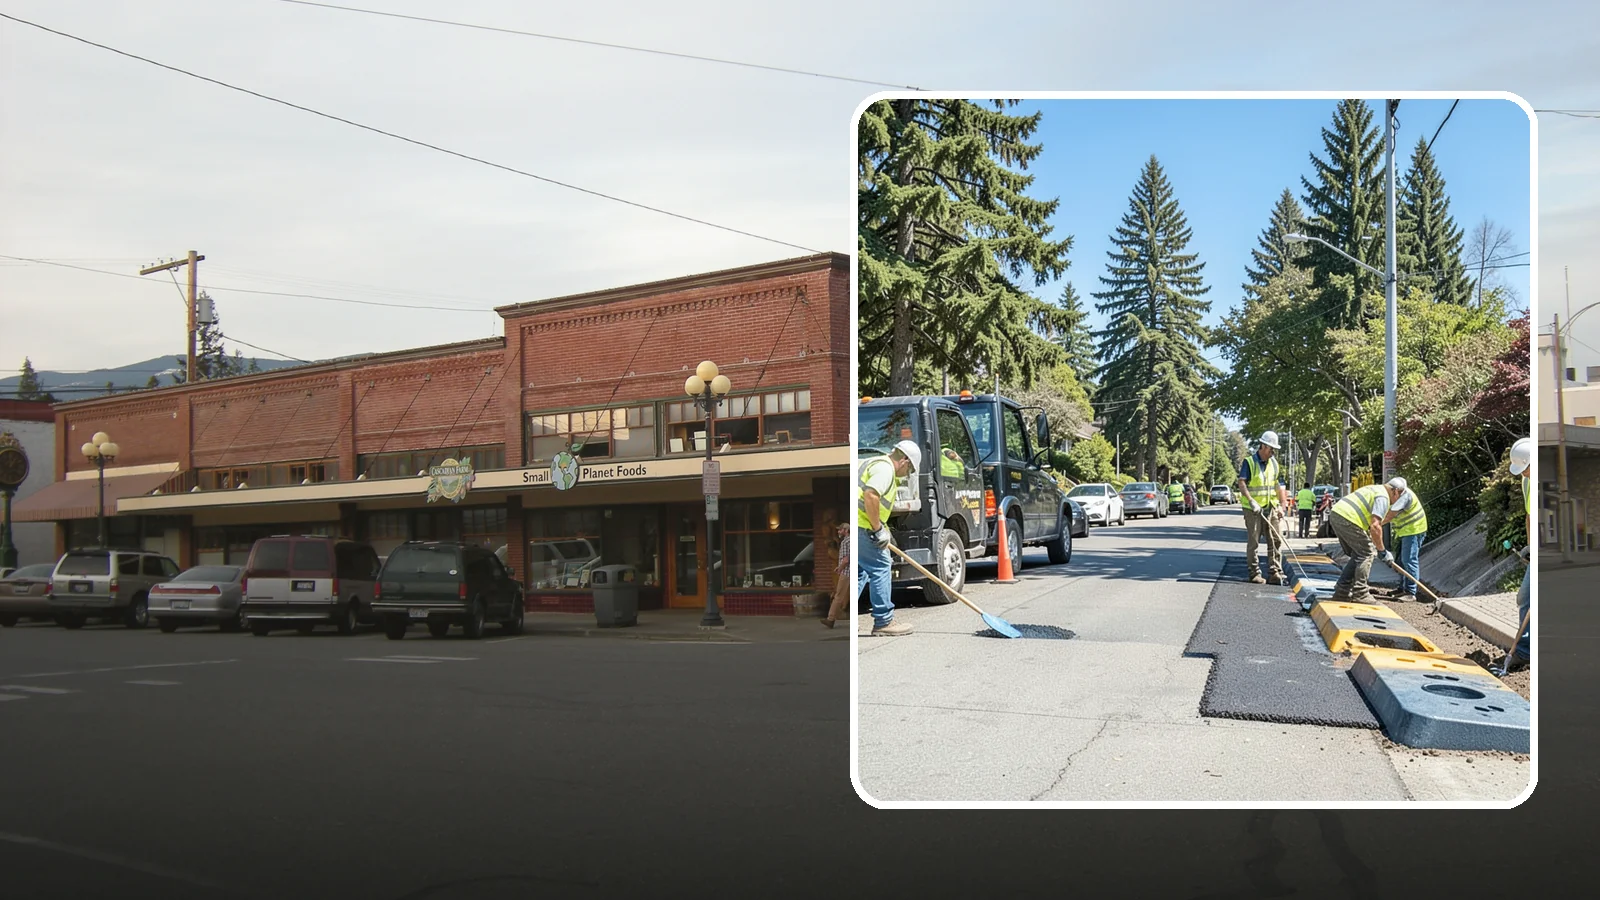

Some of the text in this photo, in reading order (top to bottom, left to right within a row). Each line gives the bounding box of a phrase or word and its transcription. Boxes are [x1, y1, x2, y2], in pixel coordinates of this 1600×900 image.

[523, 464, 646, 482] Small Planet Foods
